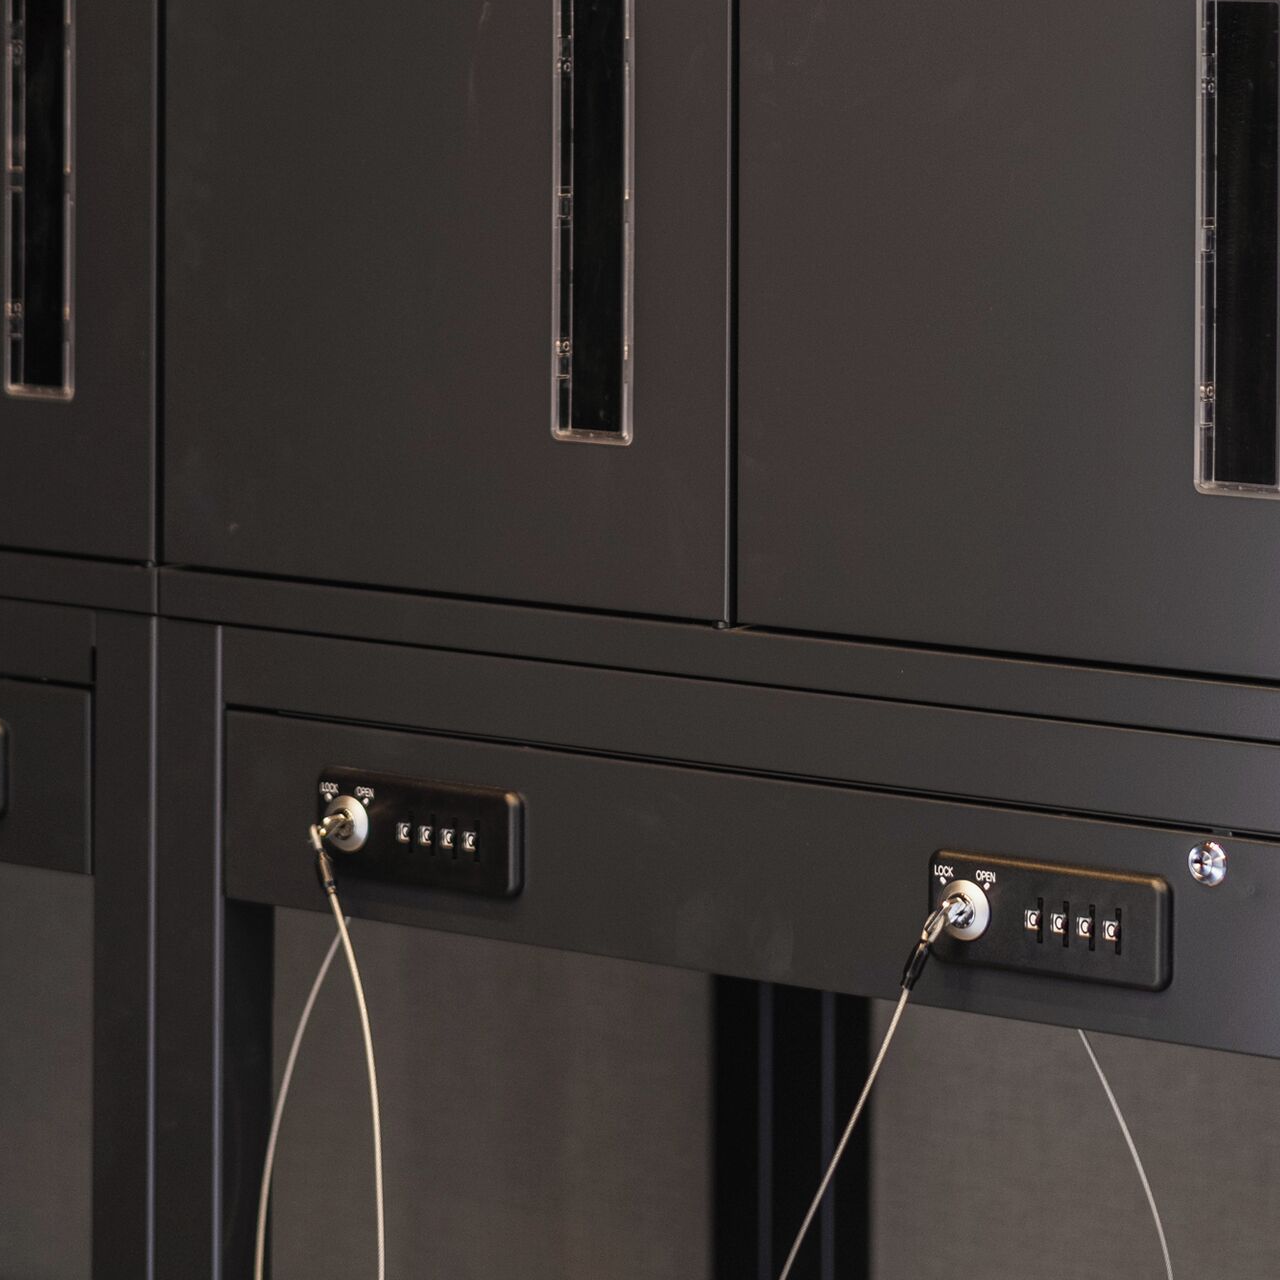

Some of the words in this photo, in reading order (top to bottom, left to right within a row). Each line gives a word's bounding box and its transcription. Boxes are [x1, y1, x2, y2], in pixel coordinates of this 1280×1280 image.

[320, 782, 339, 794] LOCK
[354, 786, 374, 798] OPEN
[934, 865, 954, 878] LOCK
[975, 870, 996, 883] OPEN
